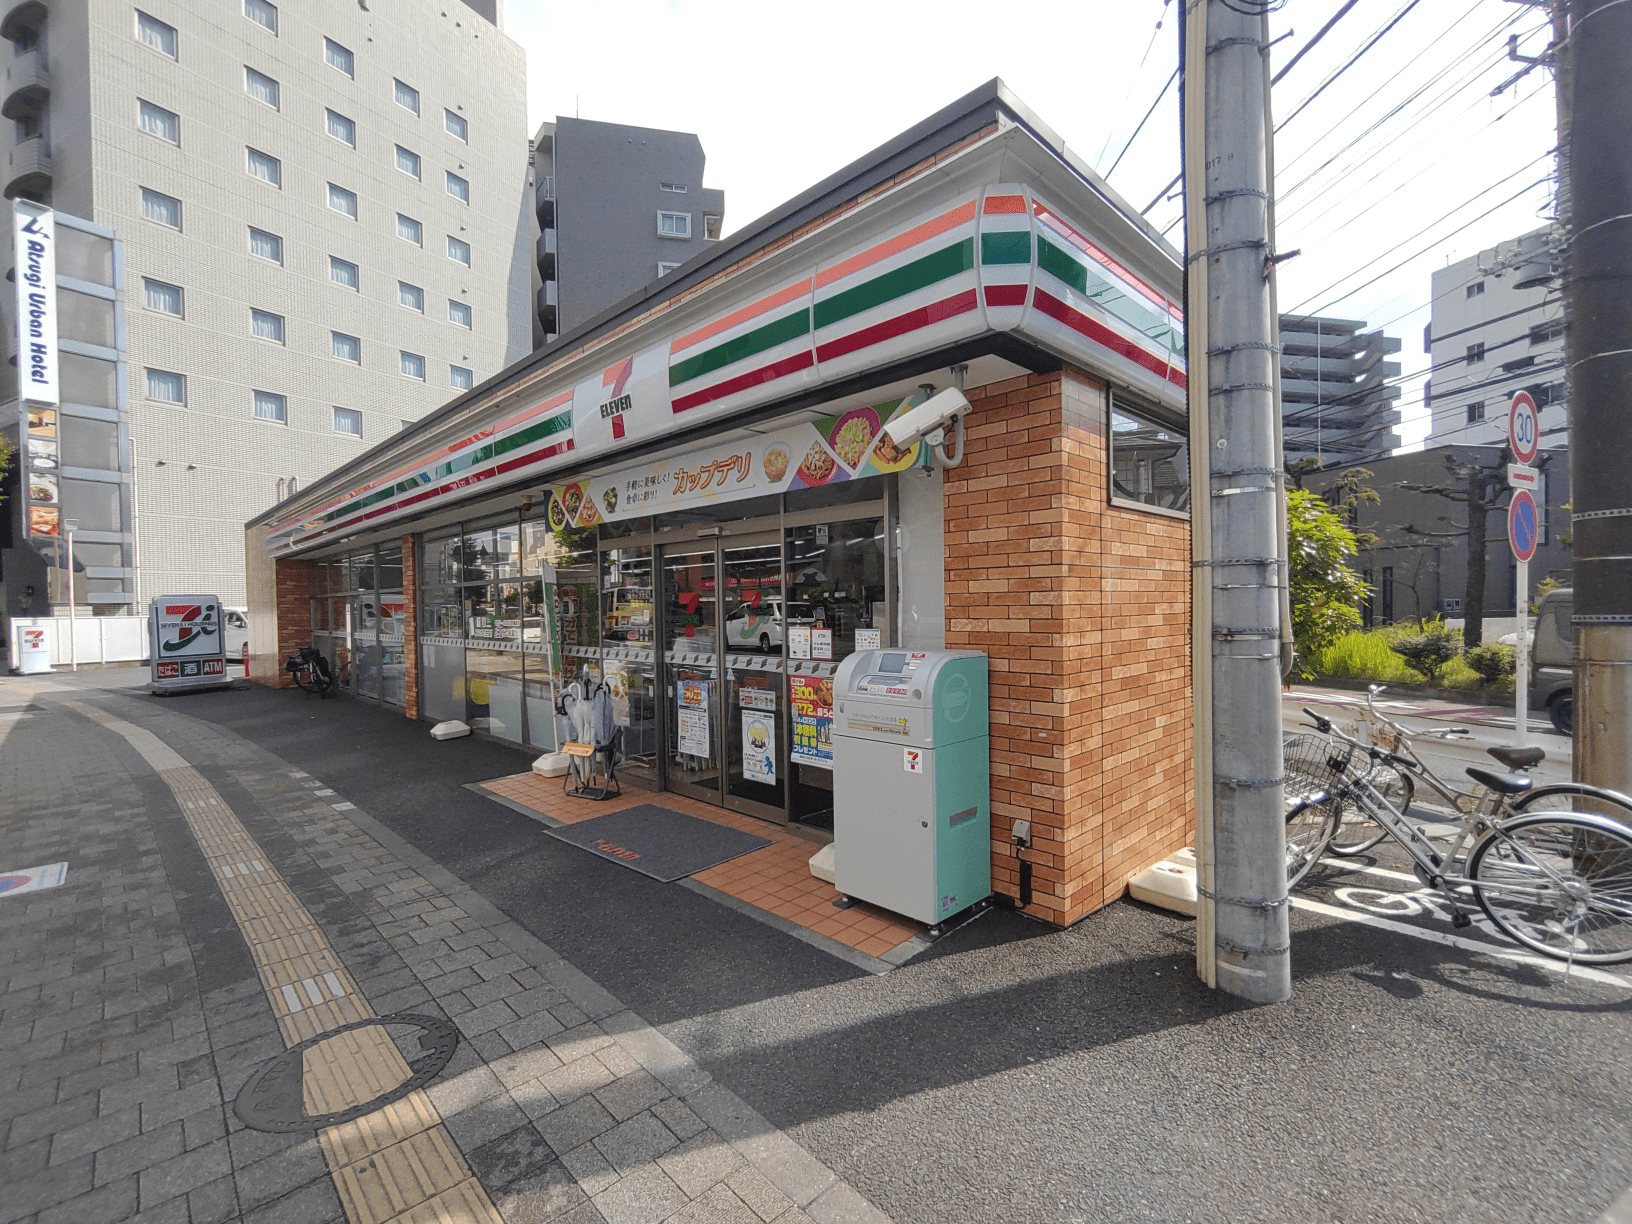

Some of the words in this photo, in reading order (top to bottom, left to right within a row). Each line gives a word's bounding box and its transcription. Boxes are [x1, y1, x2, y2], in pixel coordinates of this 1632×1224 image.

[23, 238, 47, 289] Atsugi
[28, 292, 47, 338] Urban
[30, 342, 49, 384] Hotel
[1517, 413, 1533, 444] 30
[673, 451, 752, 495] カップデリ
[158, 665, 178, 677] たばこ
[203, 661, 222, 673] ATM
